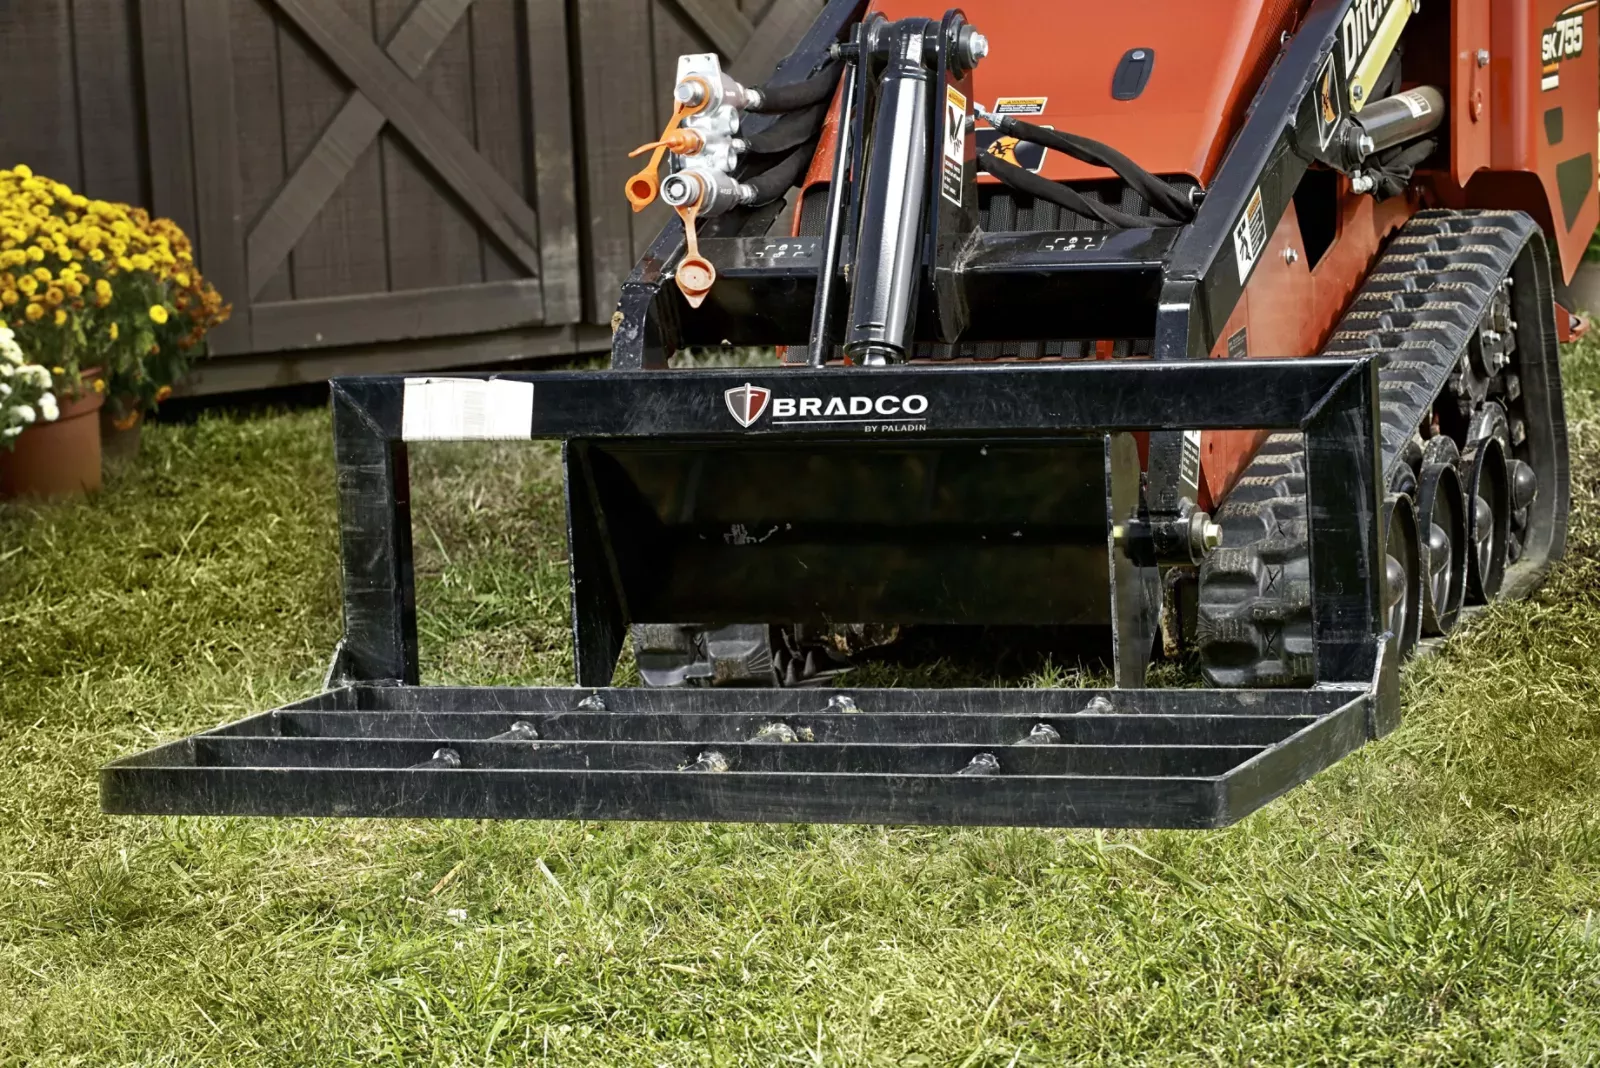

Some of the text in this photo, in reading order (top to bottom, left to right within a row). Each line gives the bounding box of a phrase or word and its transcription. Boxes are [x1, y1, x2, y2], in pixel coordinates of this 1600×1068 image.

[1541, 15, 1583, 61] SK755
[772, 394, 929, 417] BRADCO
[864, 424, 927, 433] BY PALADIN
